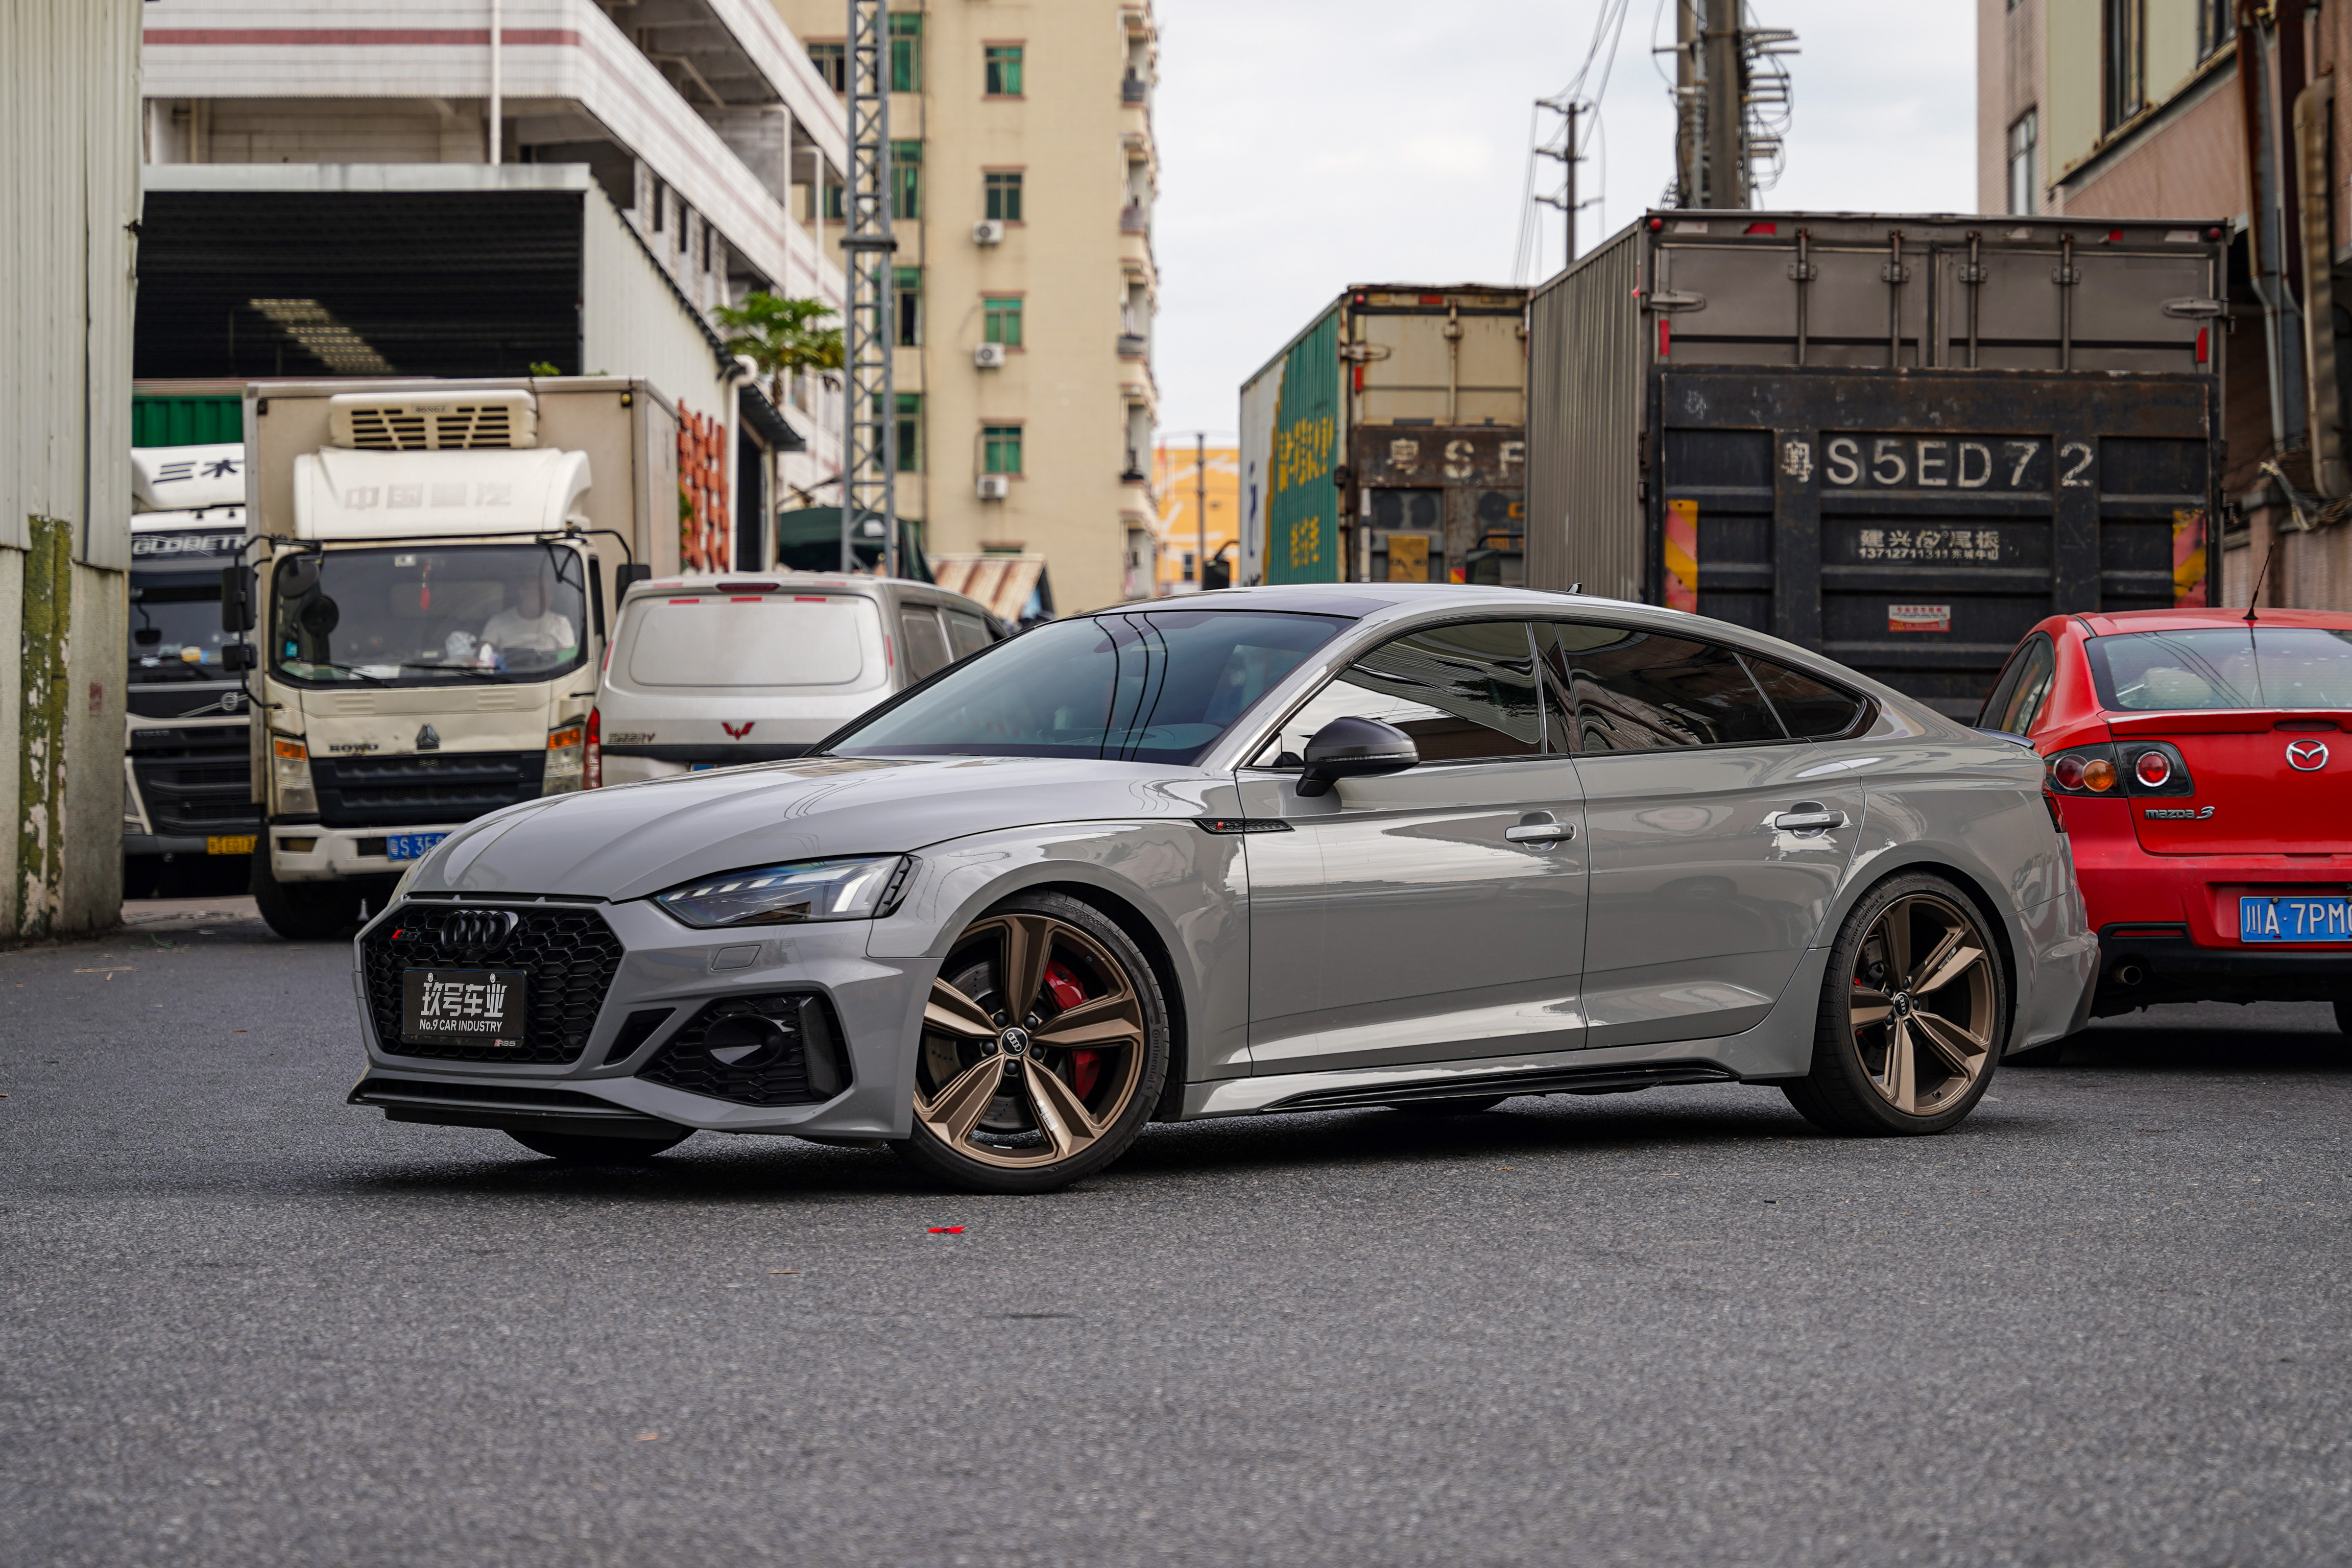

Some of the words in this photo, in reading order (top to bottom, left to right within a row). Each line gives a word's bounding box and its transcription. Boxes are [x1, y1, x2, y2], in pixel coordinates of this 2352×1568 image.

[421, 982, 508, 1018] 玖号车业
[419, 1019, 439, 1031] No.9
[439, 1020, 457, 1031] CAR
[458, 1020, 503, 1032] INDUSTRY
